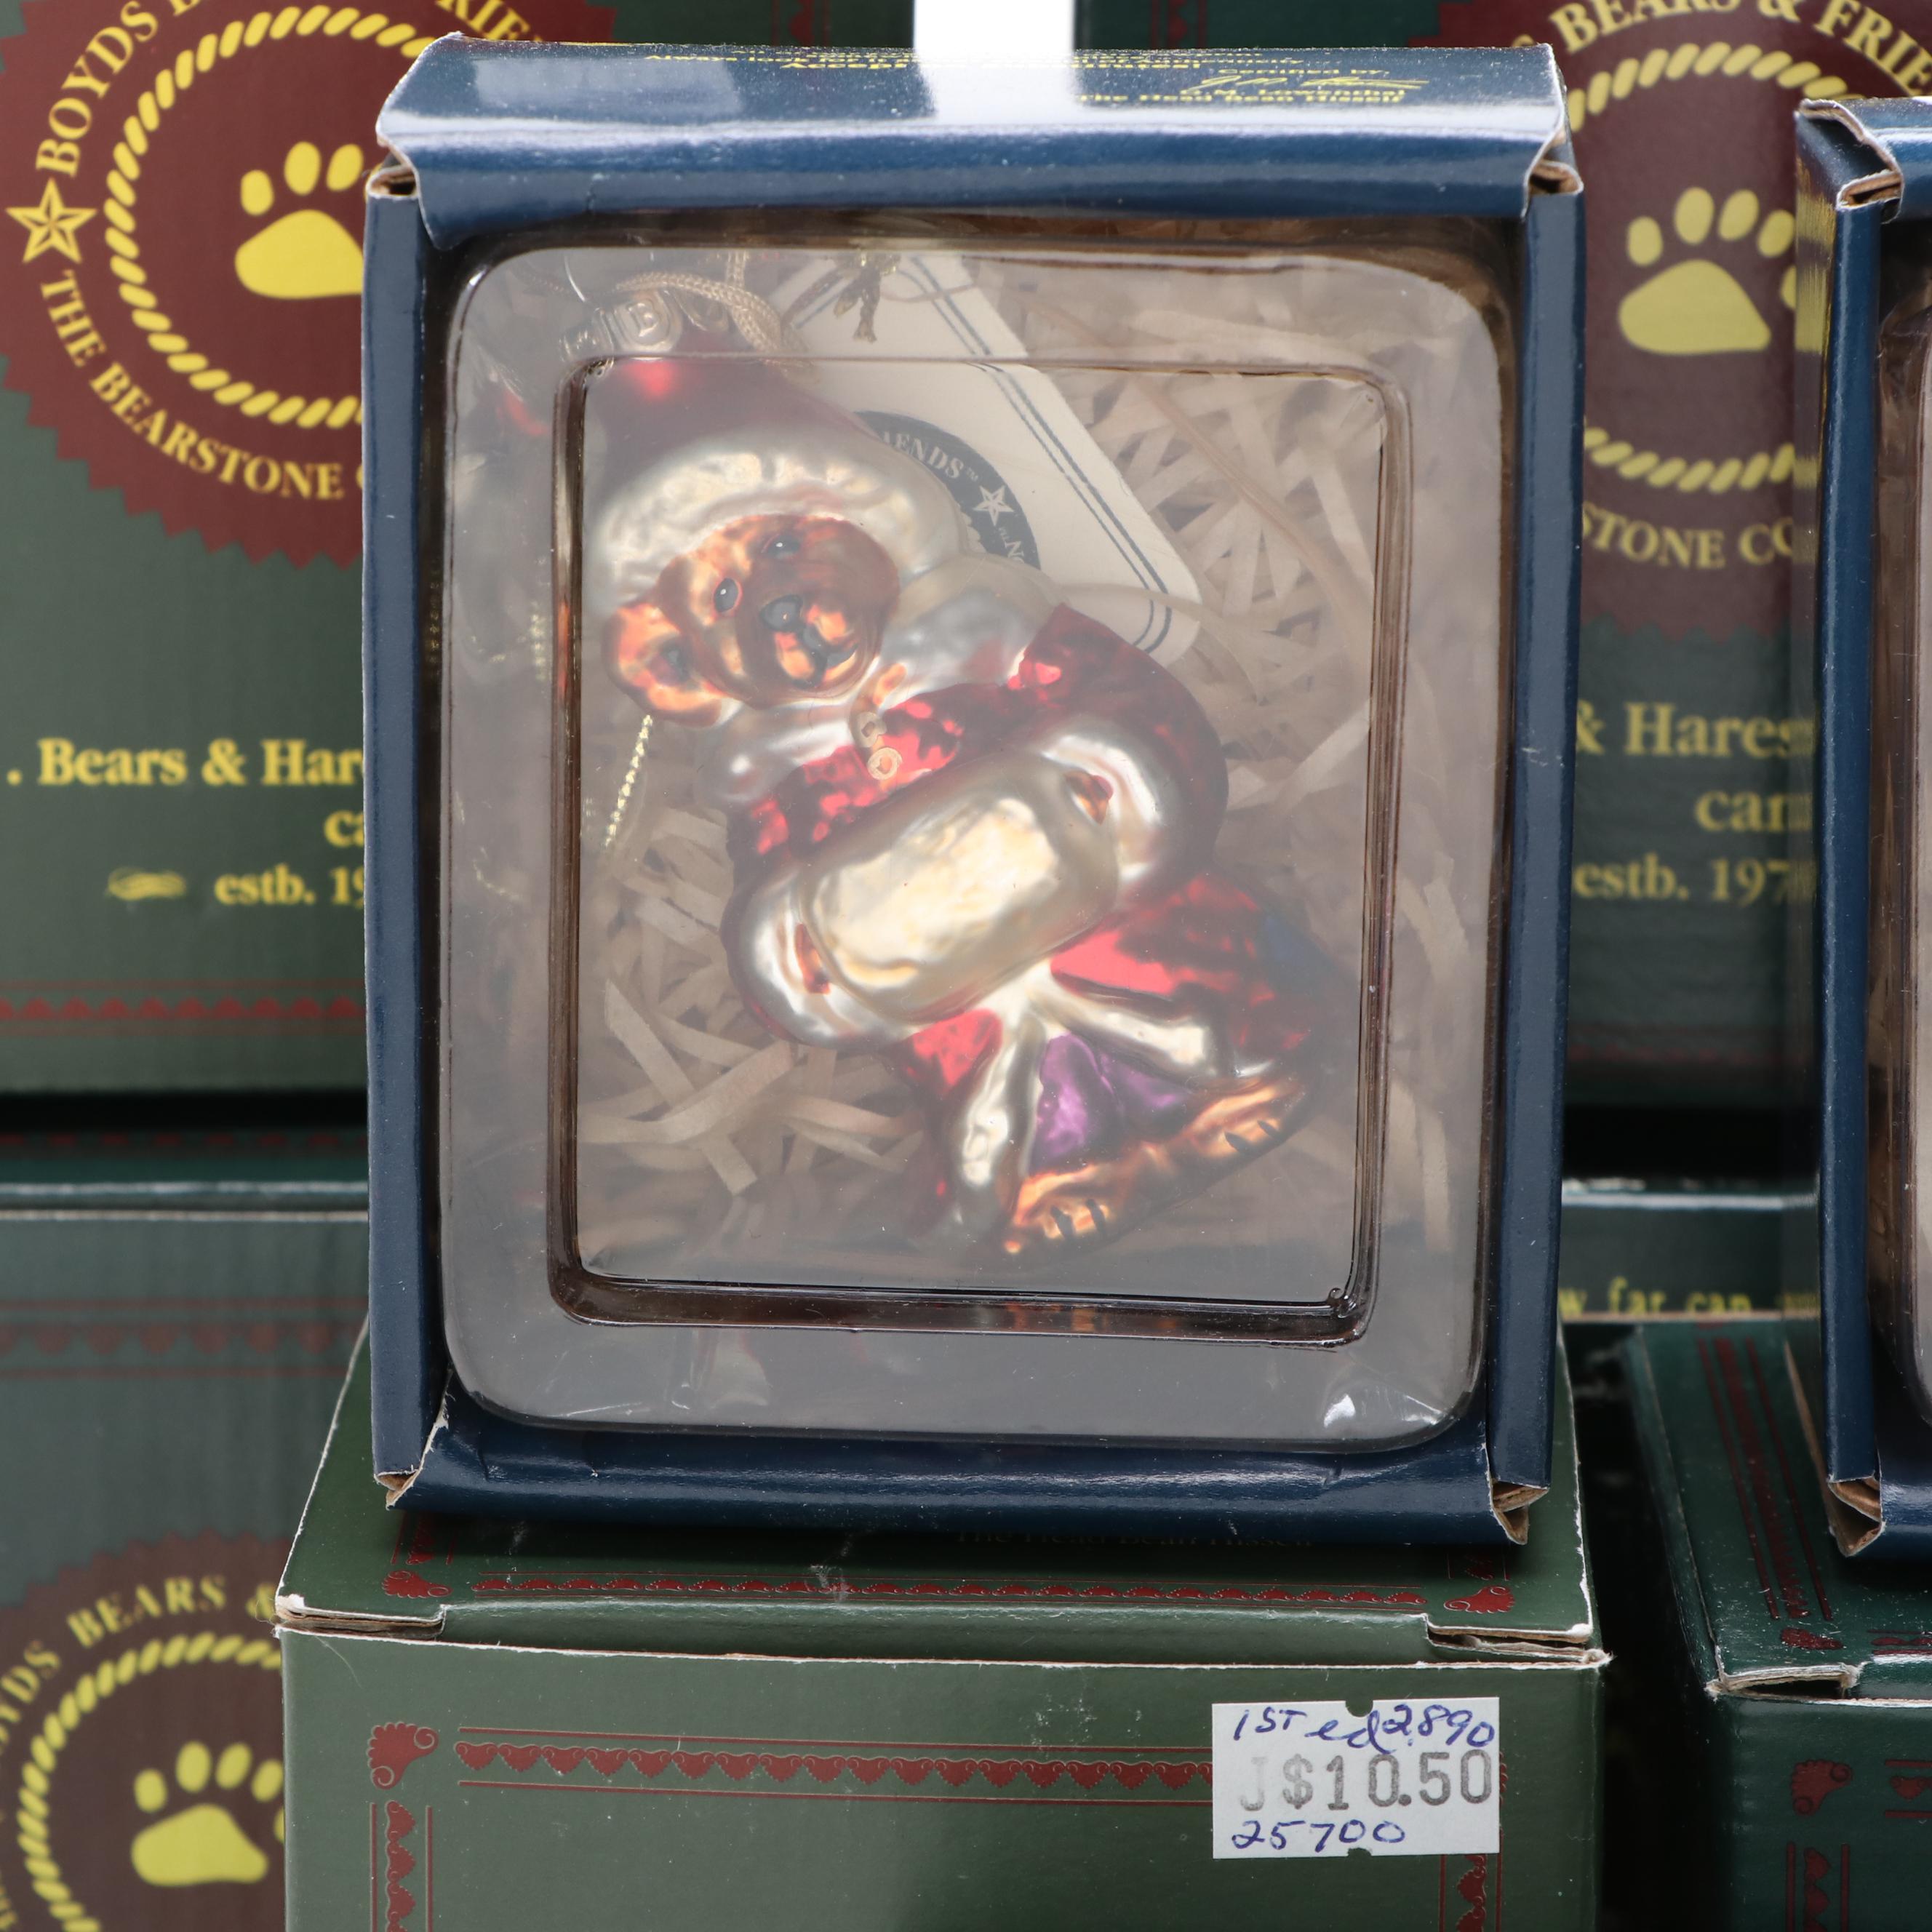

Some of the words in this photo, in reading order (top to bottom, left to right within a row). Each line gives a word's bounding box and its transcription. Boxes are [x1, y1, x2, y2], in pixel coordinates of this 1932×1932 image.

[1813, 0, 1932, 97] FRIE
[35, 3, 160, 177] BOYDS
[40, 269, 107, 367] THE
[89, 362, 344, 500] BEARSTONE
[37, 737, 188, 786] Bears
[201, 738, 247, 786] &
[260, 738, 364, 786] Har
[214, 863, 316, 906] estb.
[1572, 852, 1691, 901] estb.
[65, 1574, 227, 1648] BEARS
